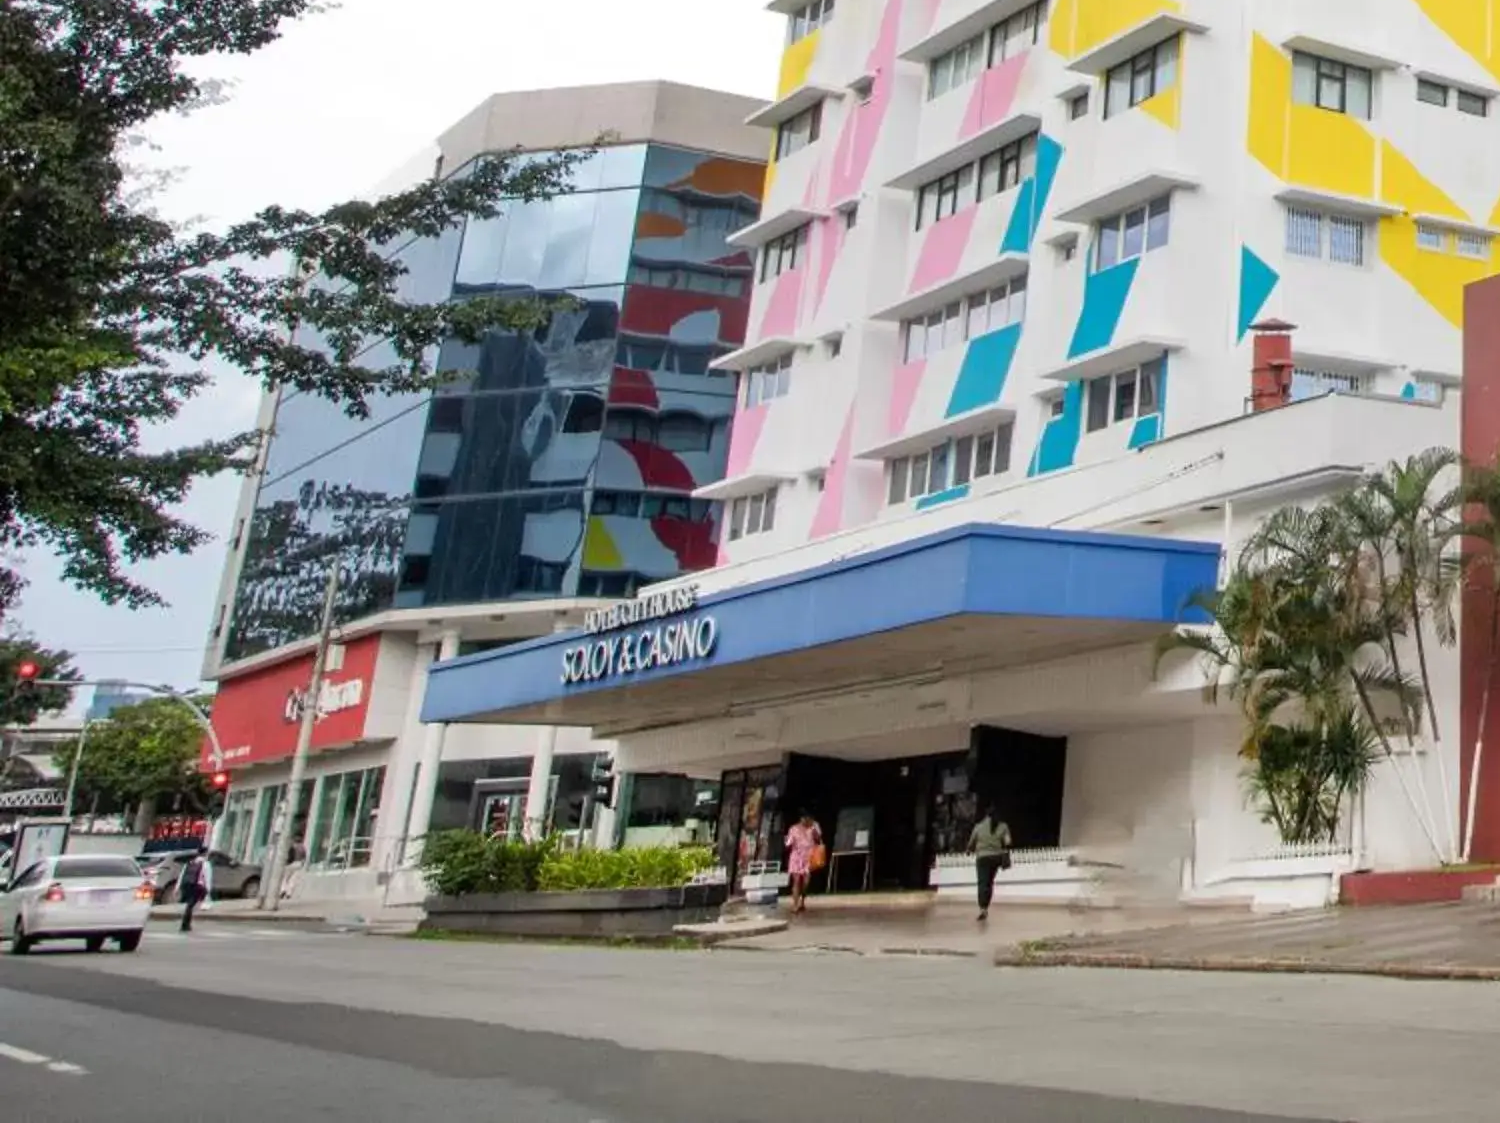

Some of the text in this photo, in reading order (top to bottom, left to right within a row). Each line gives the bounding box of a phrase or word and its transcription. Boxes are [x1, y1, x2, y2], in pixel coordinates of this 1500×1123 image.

[560, 615, 717, 684] SOLOY & CASINO
